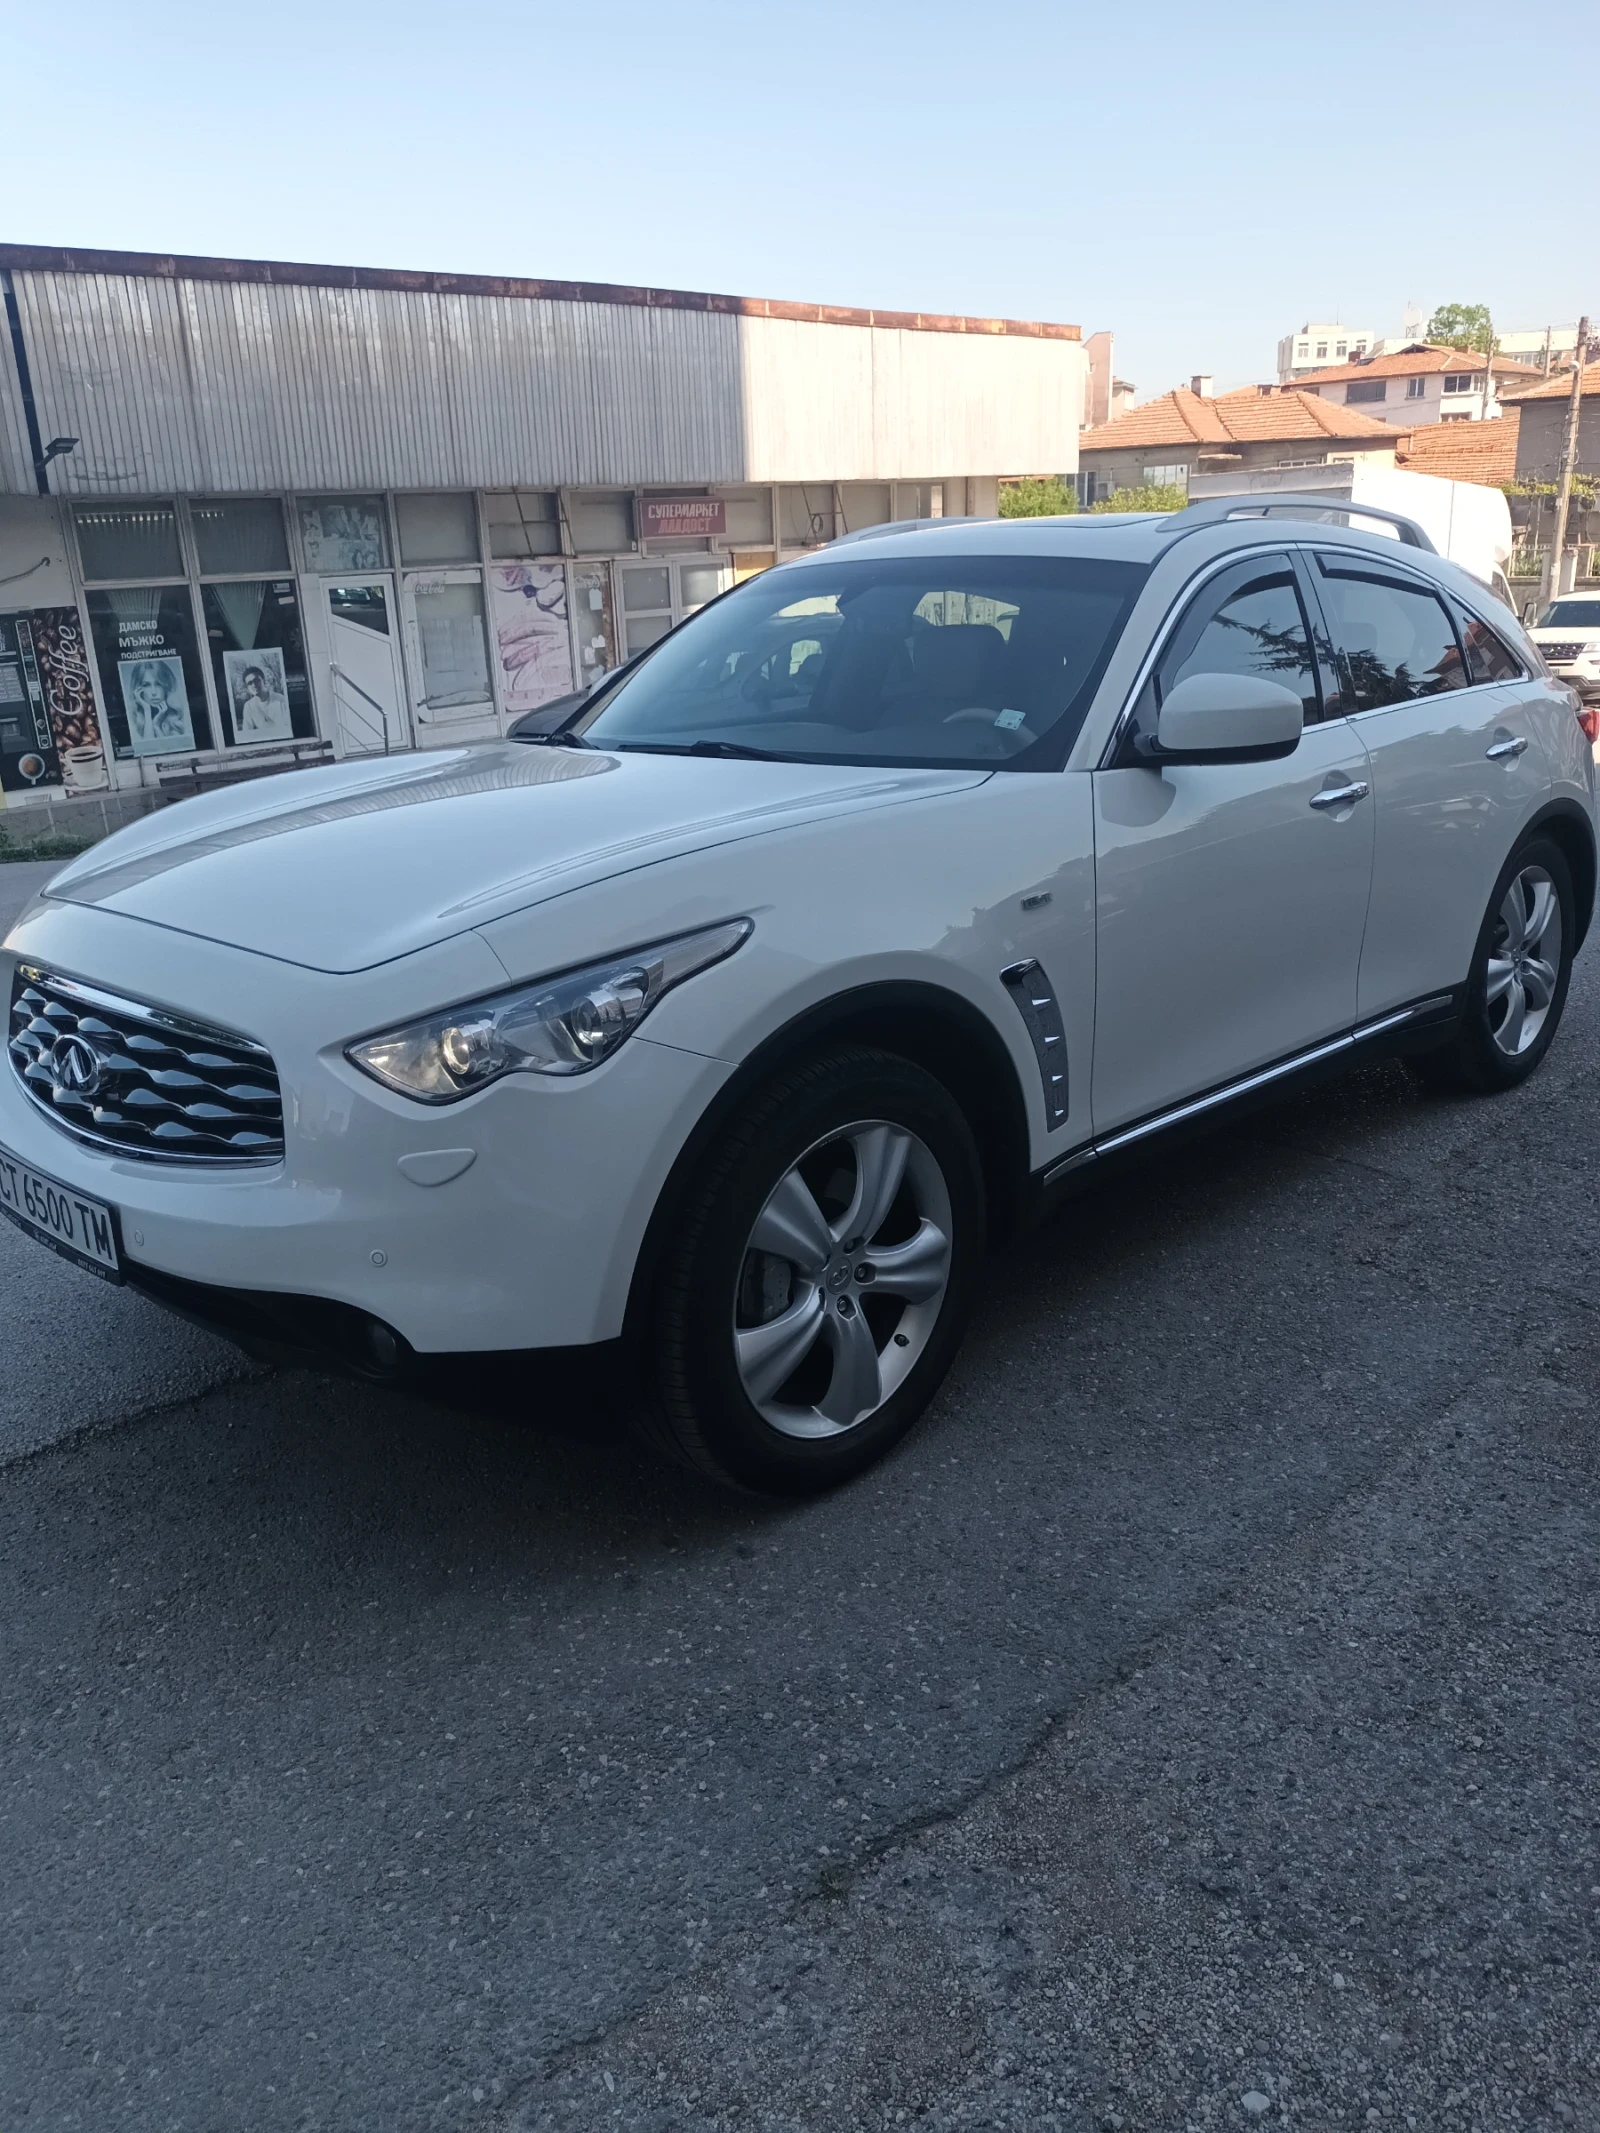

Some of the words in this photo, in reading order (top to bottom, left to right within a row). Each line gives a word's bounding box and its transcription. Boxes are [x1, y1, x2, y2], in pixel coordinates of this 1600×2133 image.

[648, 502, 720, 519] СУПЕРМАРКЕТ
[118, 620, 158, 633] ДАМСКО
[118, 634, 165, 648] МЪЖКО
[120, 648, 177, 660] ПОДСТРИГВАНЕ
[48, 625, 90, 715] Coffee
[0, 1156, 19, 1208] CT
[24, 1173, 74, 1240] 6500
[74, 1200, 113, 1261] TM
